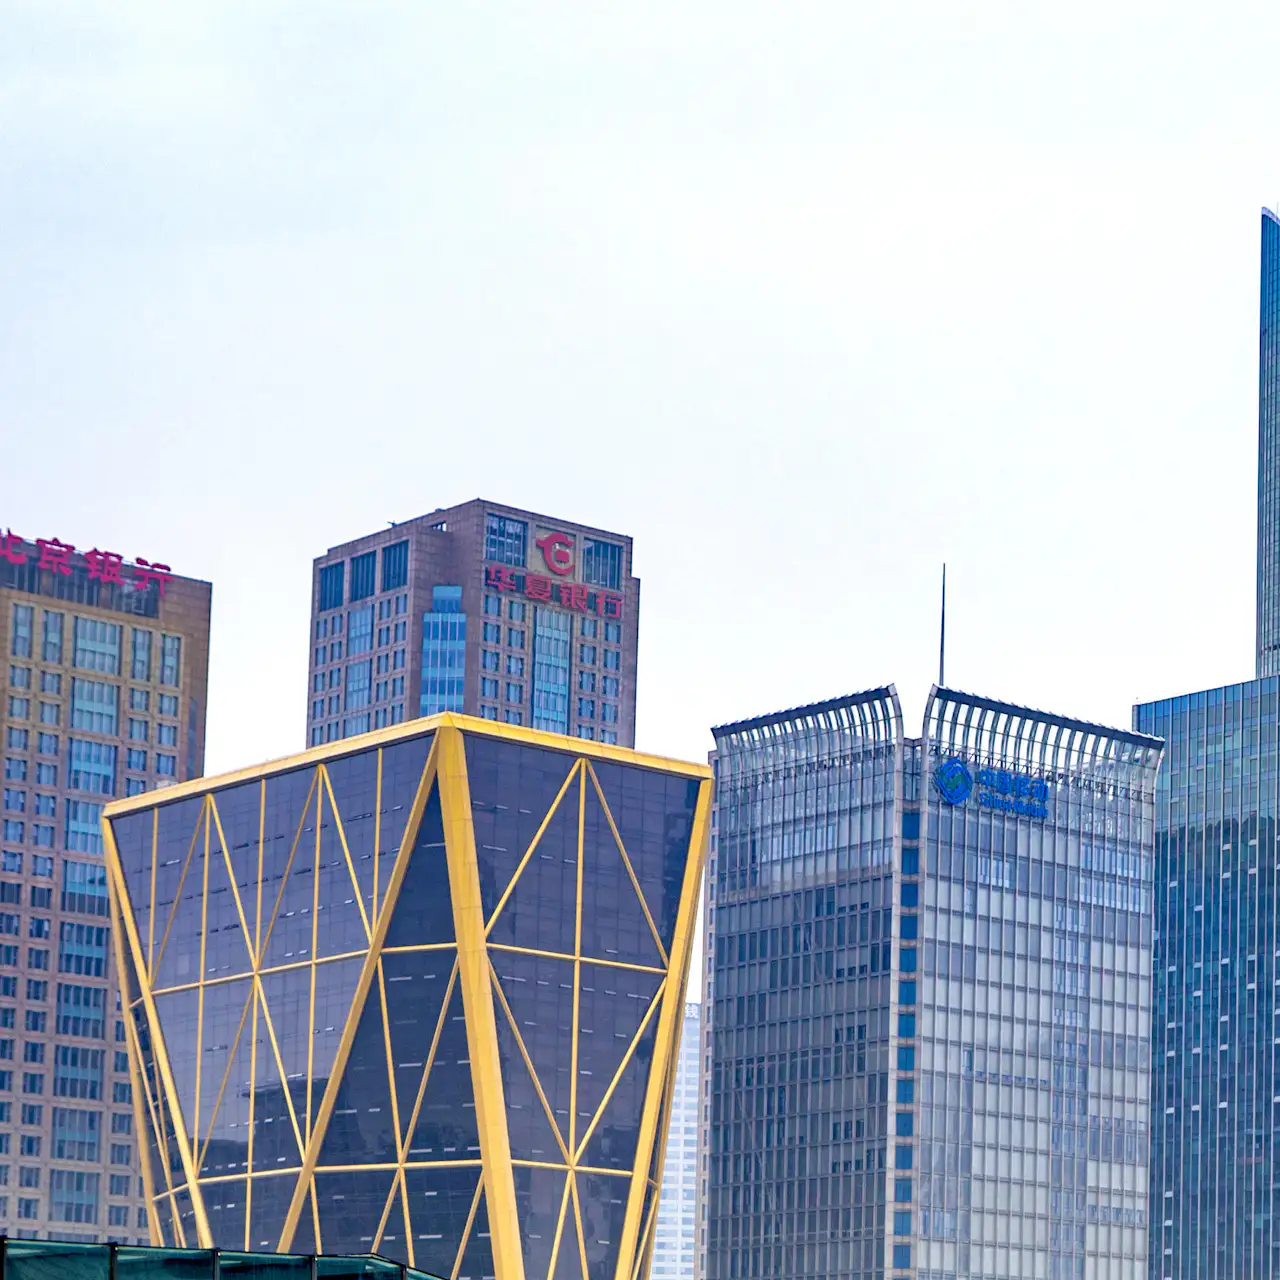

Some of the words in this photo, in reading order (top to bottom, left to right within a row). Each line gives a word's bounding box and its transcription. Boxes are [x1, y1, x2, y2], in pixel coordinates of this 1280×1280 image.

[487, 564, 624, 618] 华夏银行
[980, 767, 1048, 802] 中国移动
